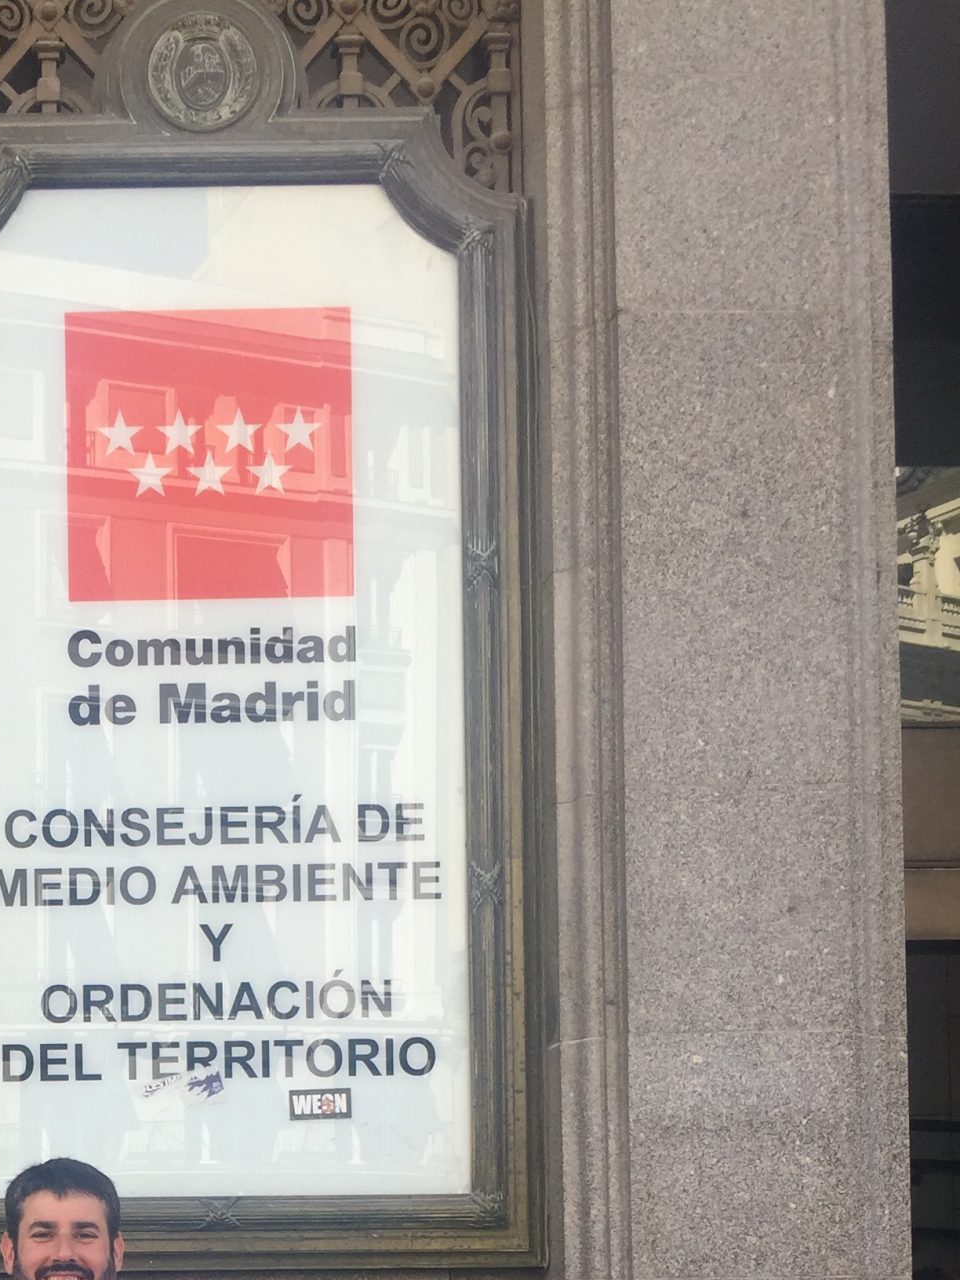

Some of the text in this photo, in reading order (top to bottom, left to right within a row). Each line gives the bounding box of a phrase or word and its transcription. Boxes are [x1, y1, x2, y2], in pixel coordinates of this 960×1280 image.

[67, 625, 357, 668] Comunidad
[68, 680, 357, 725] de Madrid
[3, 794, 425, 849] CONSEJERÍA DE
[171, 860, 442, 905] AMBIENTE
[199, 923, 233, 962] Y
[40, 969, 393, 1023] ORDENACIÓN
[2, 1037, 437, 1082] DEL TERRITORIO
